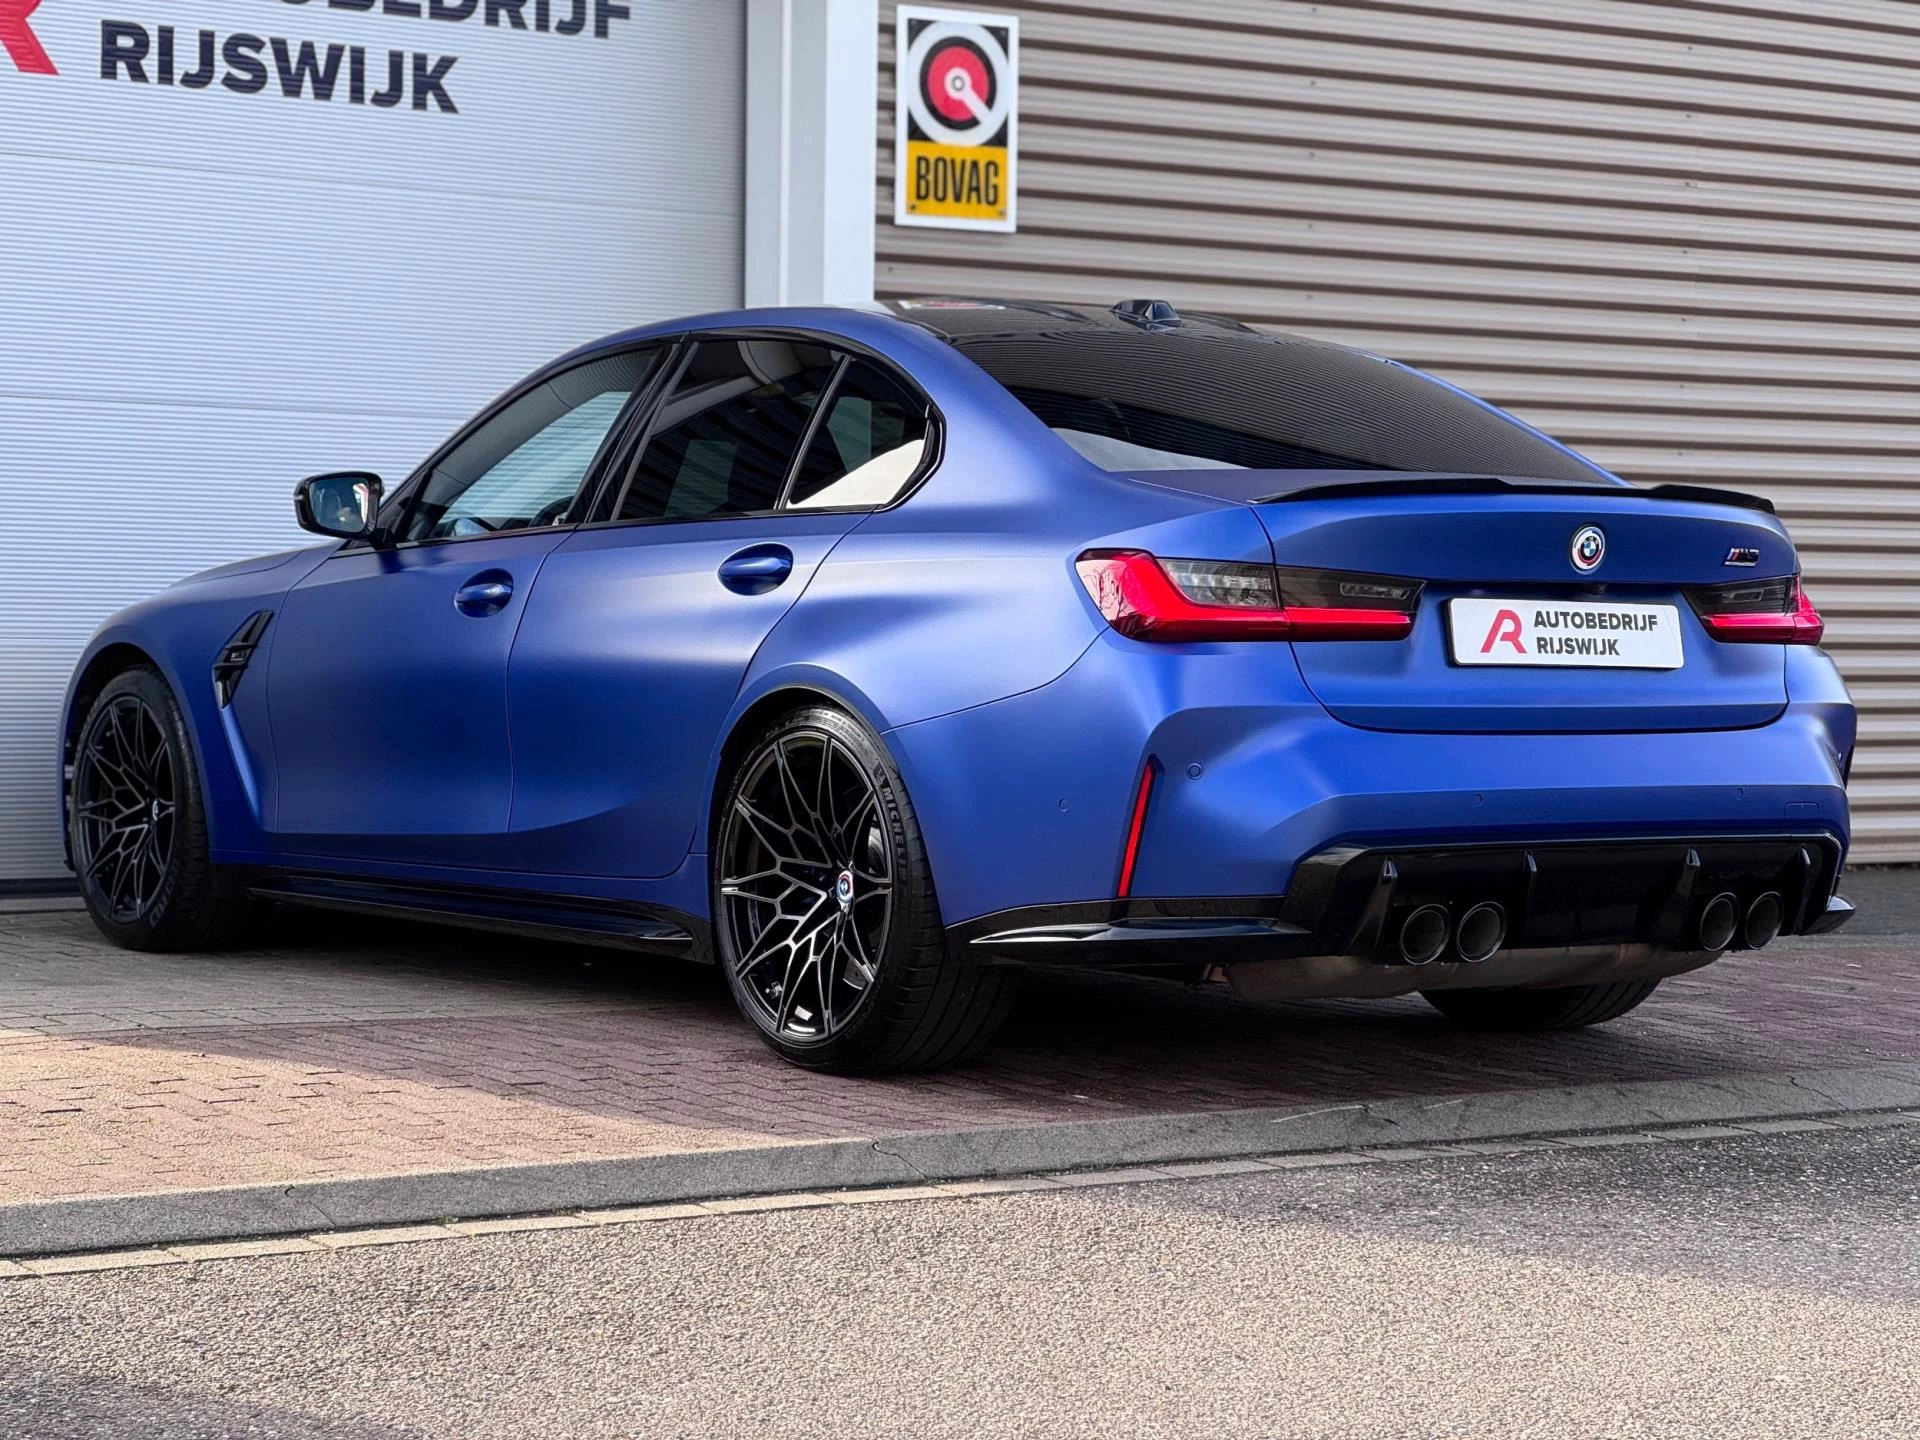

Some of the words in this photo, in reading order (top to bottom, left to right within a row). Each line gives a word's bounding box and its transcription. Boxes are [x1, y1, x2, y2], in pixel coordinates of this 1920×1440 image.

[281, 0, 631, 39] RIJF
[100, 20, 459, 114] RIJSWIJK
[916, 156, 999, 205] BOVAG
[1534, 611, 1658, 631] AUTOBEDRIJF
[1536, 637, 1620, 656] RIJSWIJK
